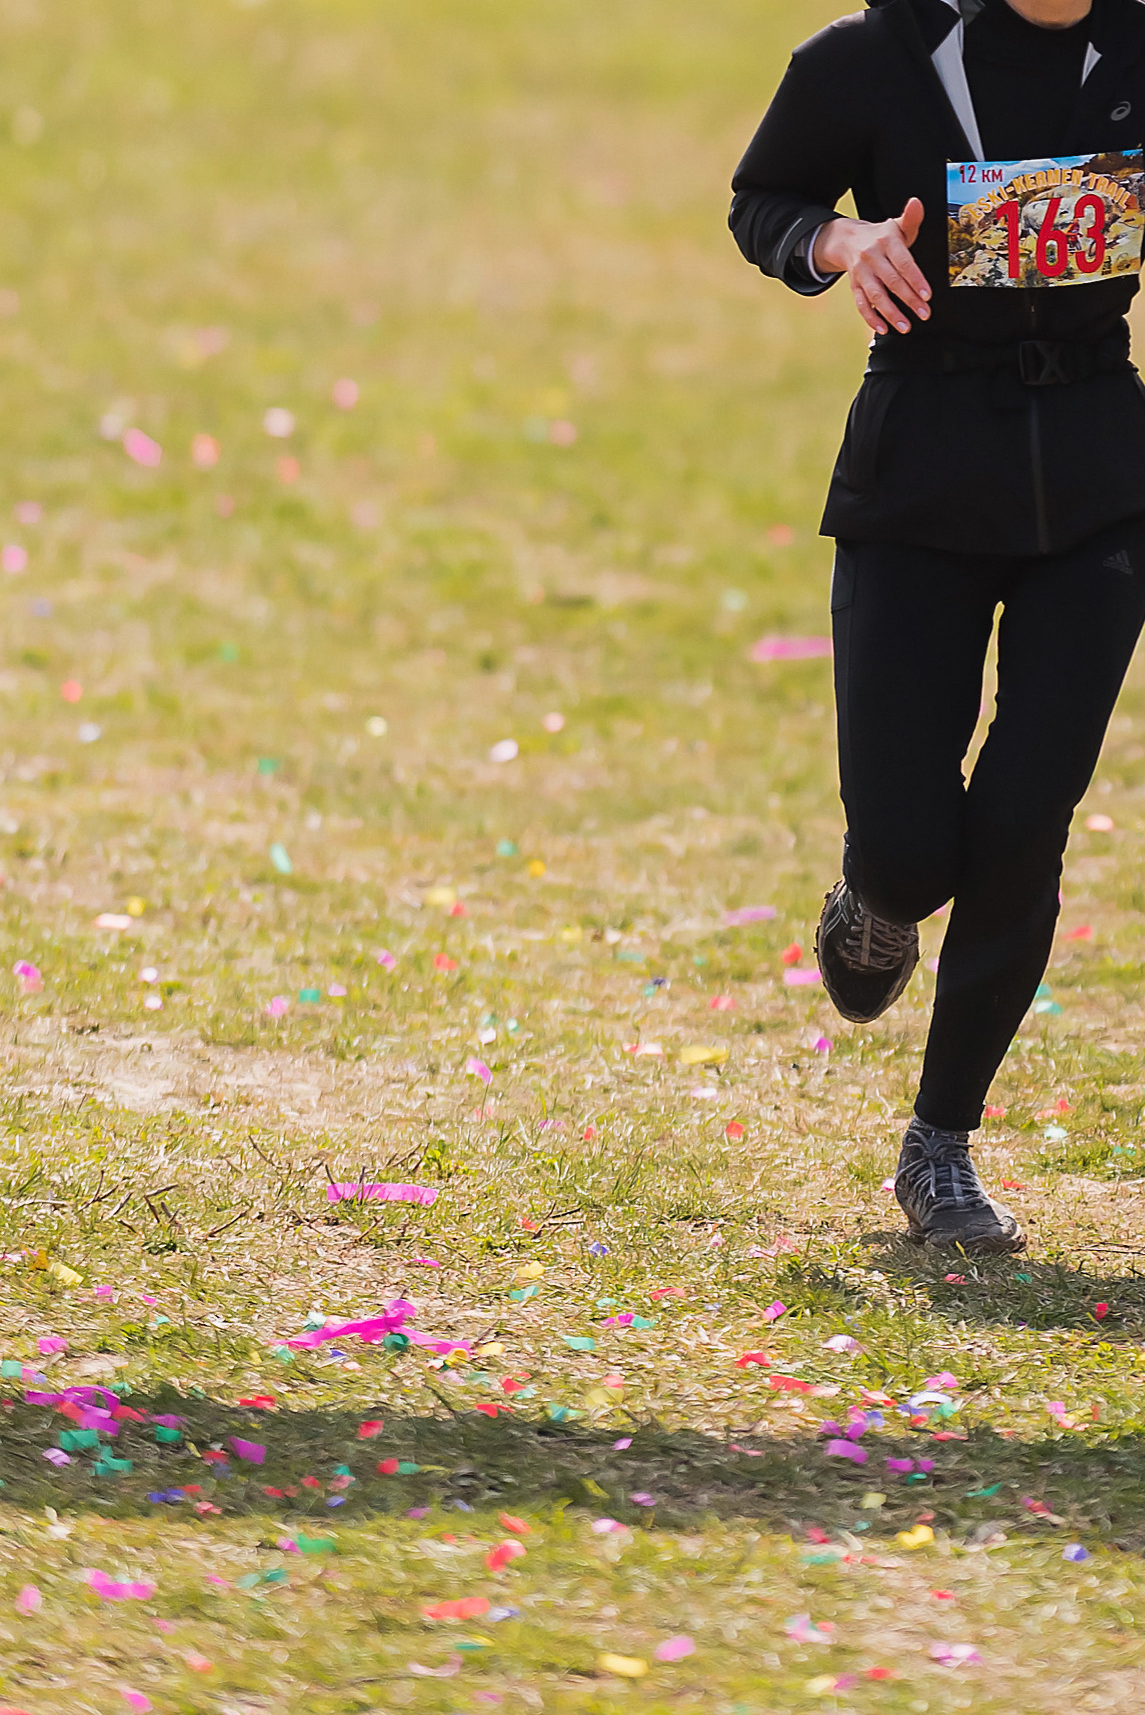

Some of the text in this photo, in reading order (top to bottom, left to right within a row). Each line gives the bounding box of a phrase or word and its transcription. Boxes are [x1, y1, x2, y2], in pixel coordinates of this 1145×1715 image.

[959, 165, 1003, 183] 12 KM
[968, 168, 1131, 220] ESKI-KERMEN TRAIL
[995, 194, 1106, 278] 163
